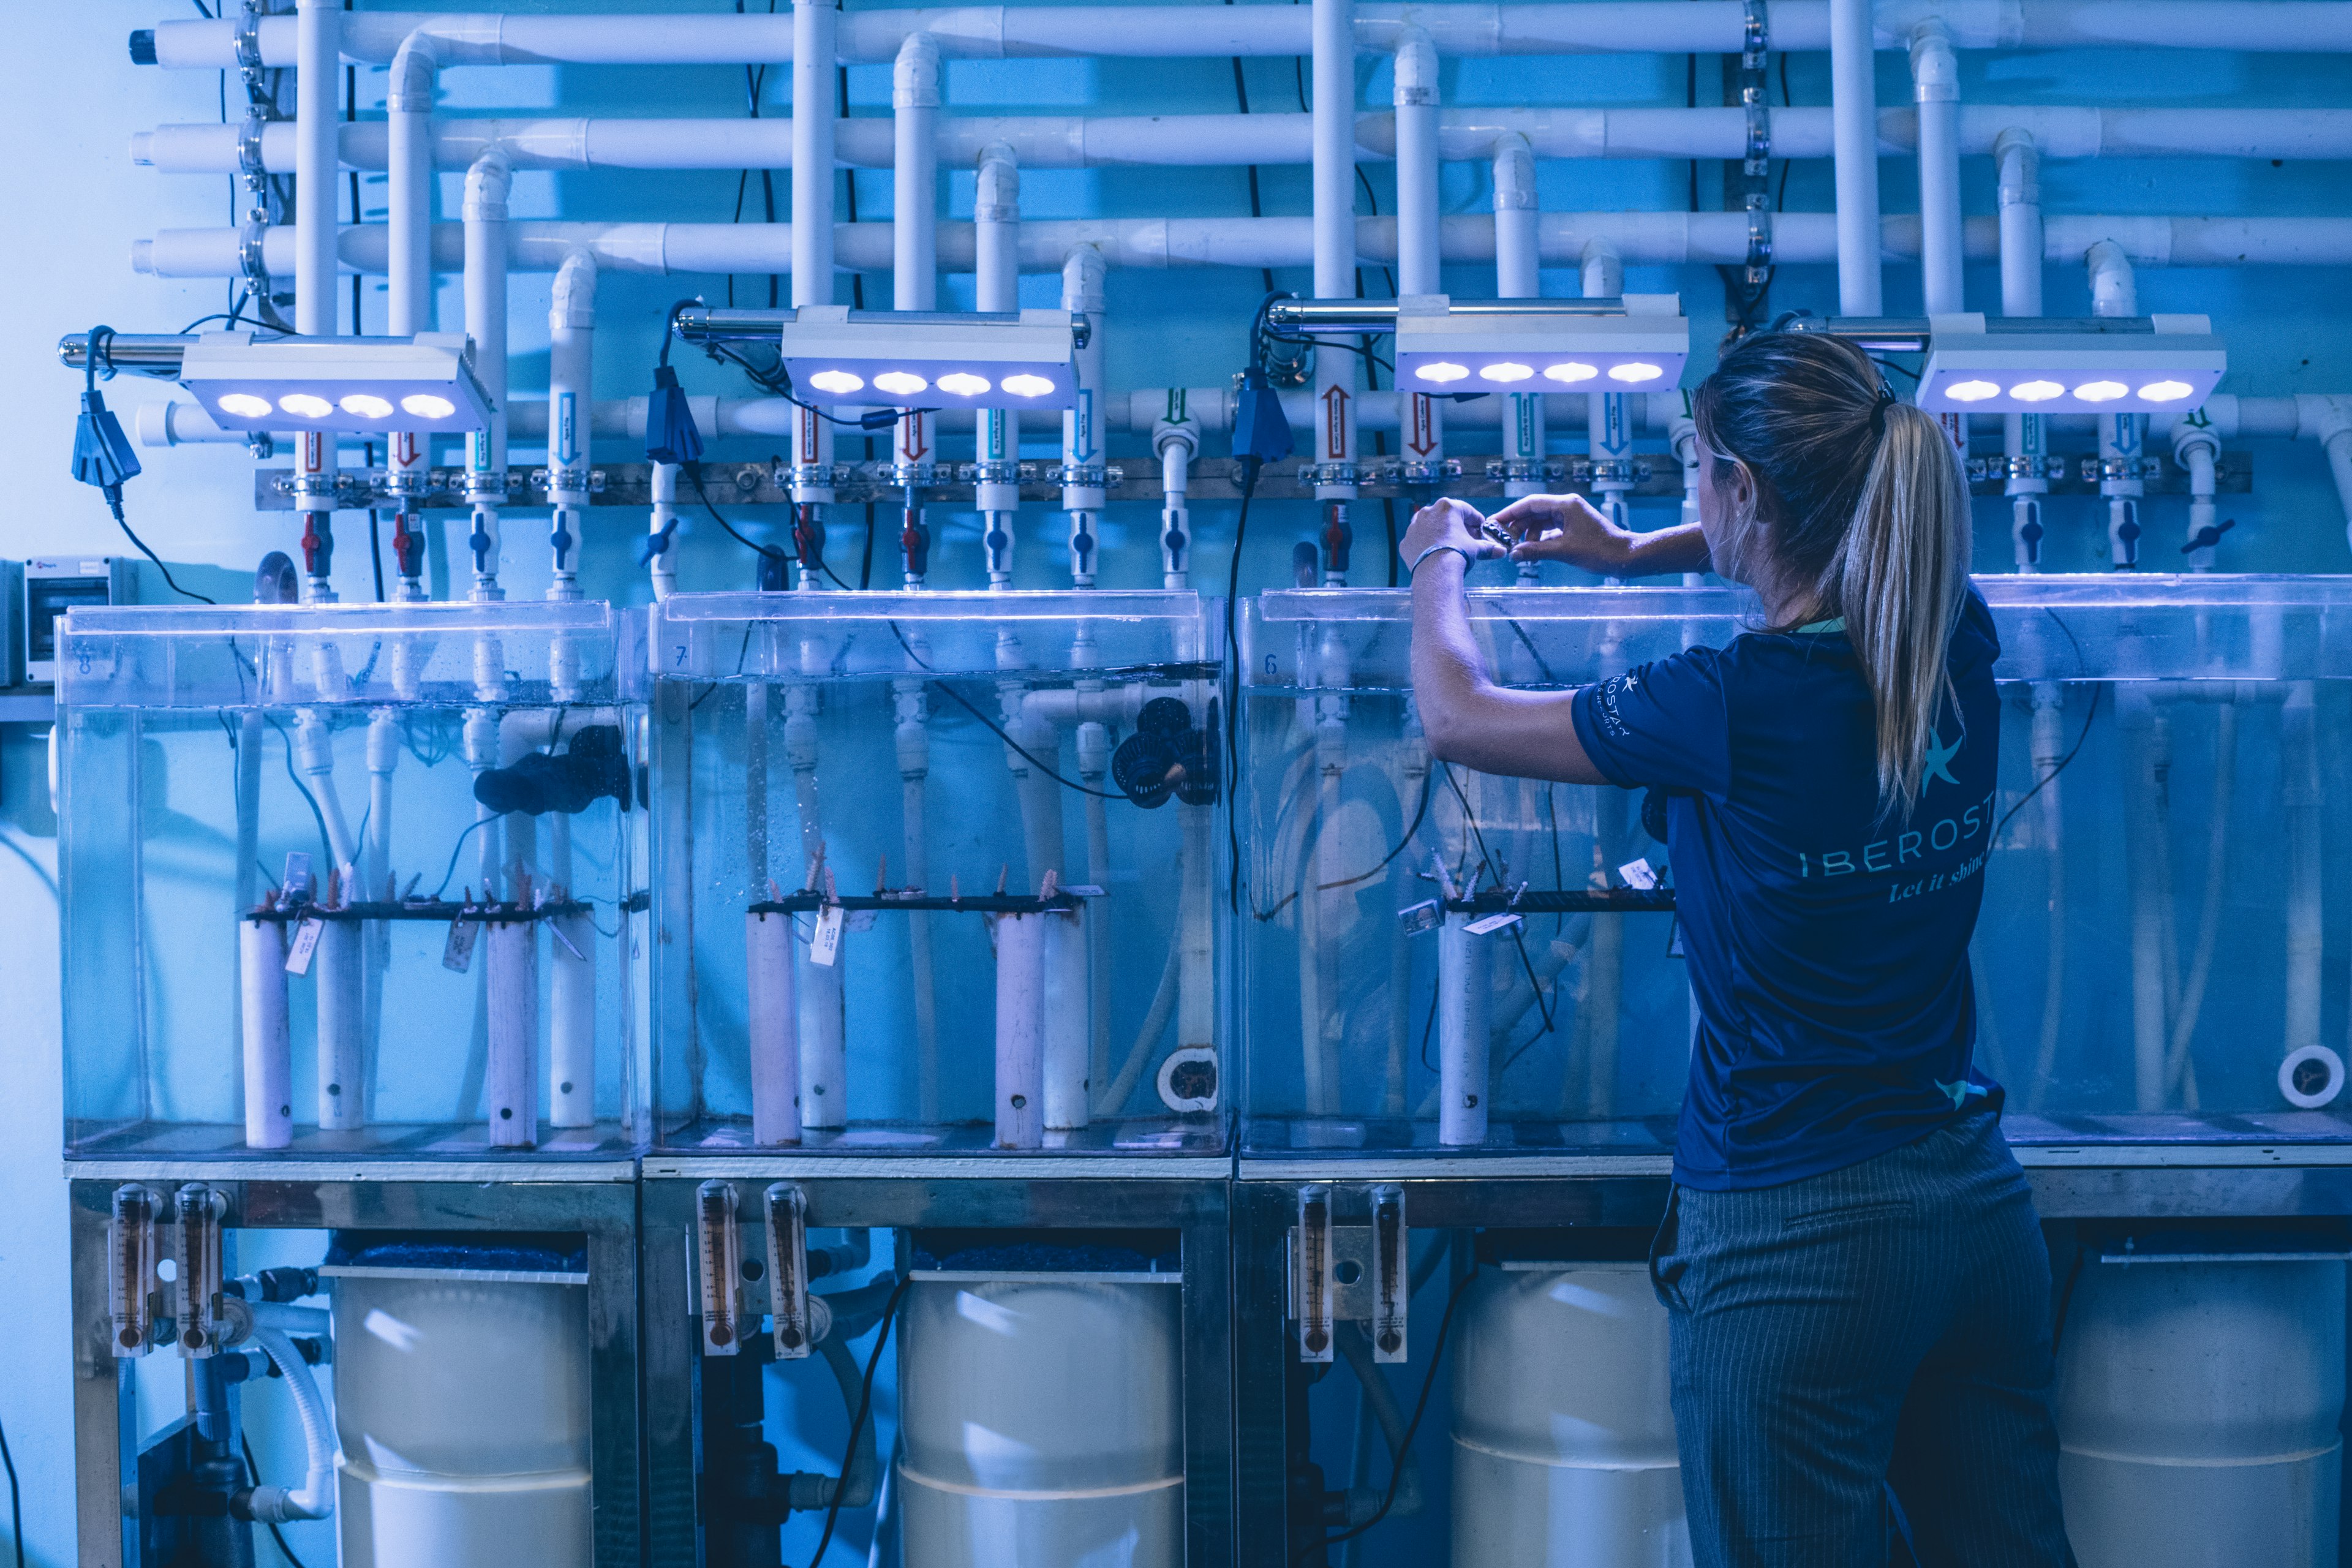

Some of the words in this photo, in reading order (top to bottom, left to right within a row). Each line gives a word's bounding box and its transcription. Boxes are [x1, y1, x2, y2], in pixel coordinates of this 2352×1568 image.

[676, 646, 687, 666] 7
[1265, 654, 1277, 675] 6
[1889, 878, 1924, 903] Let
[1928, 871, 1945, 892] it
